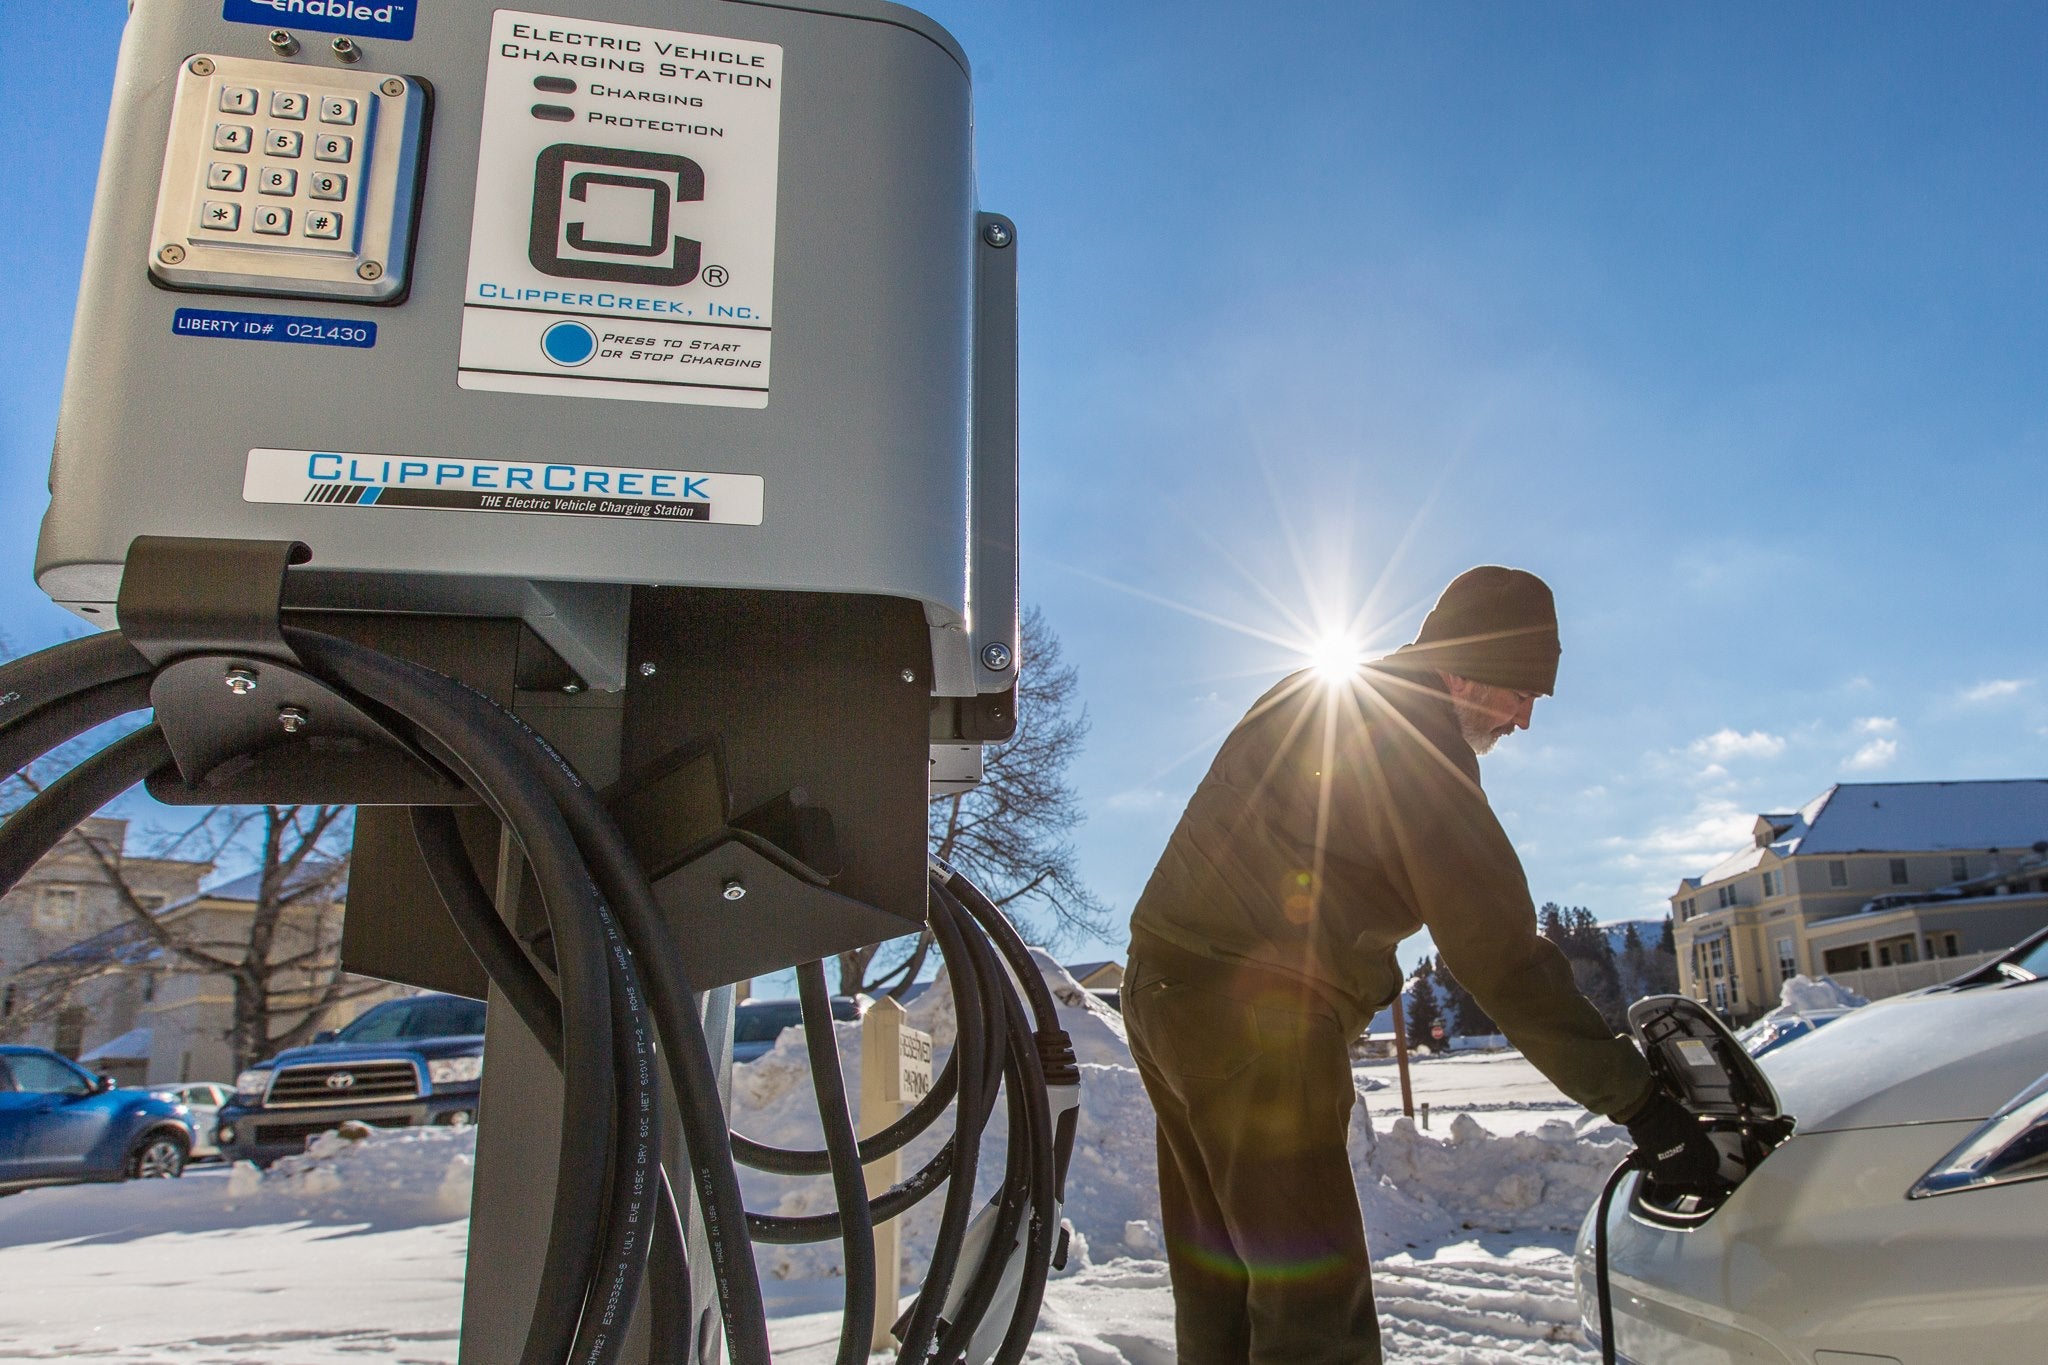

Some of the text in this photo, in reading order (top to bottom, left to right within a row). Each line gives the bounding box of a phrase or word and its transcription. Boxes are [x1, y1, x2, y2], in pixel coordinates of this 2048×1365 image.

[513, 24, 766, 68] ELECTRIC VEHICLE
[501, 44, 772, 89] CHARGING STATION
[236, 93, 244, 105] 1
[283, 99, 294, 110] 2
[590, 84, 703, 108] CHARGING
[332, 104, 343, 116] 3
[588, 111, 723, 137] PROTECTION
[226, 131, 238, 143] 4
[277, 136, 289, 148] 5
[326, 141, 338, 153] 6
[221, 170, 232, 182] 7
[272, 174, 283, 186] 8
[321, 179, 332, 191] 9
[266, 213, 277, 225] 0
[708, 303, 761, 320] INC.
[178, 317, 367, 343] LIBERTY ID# 021430
[602, 333, 741, 353] PRESS TO START
[600, 349, 762, 369] OR STOP CHARGING
[480, 495, 695, 518] THE Electric Vehicle Charging Station
[600, 906, 610, 924] USA
[608, 928, 617, 940] IN
[614, 945, 628, 970] MADE
[903, 1068, 929, 1096] PARKING
